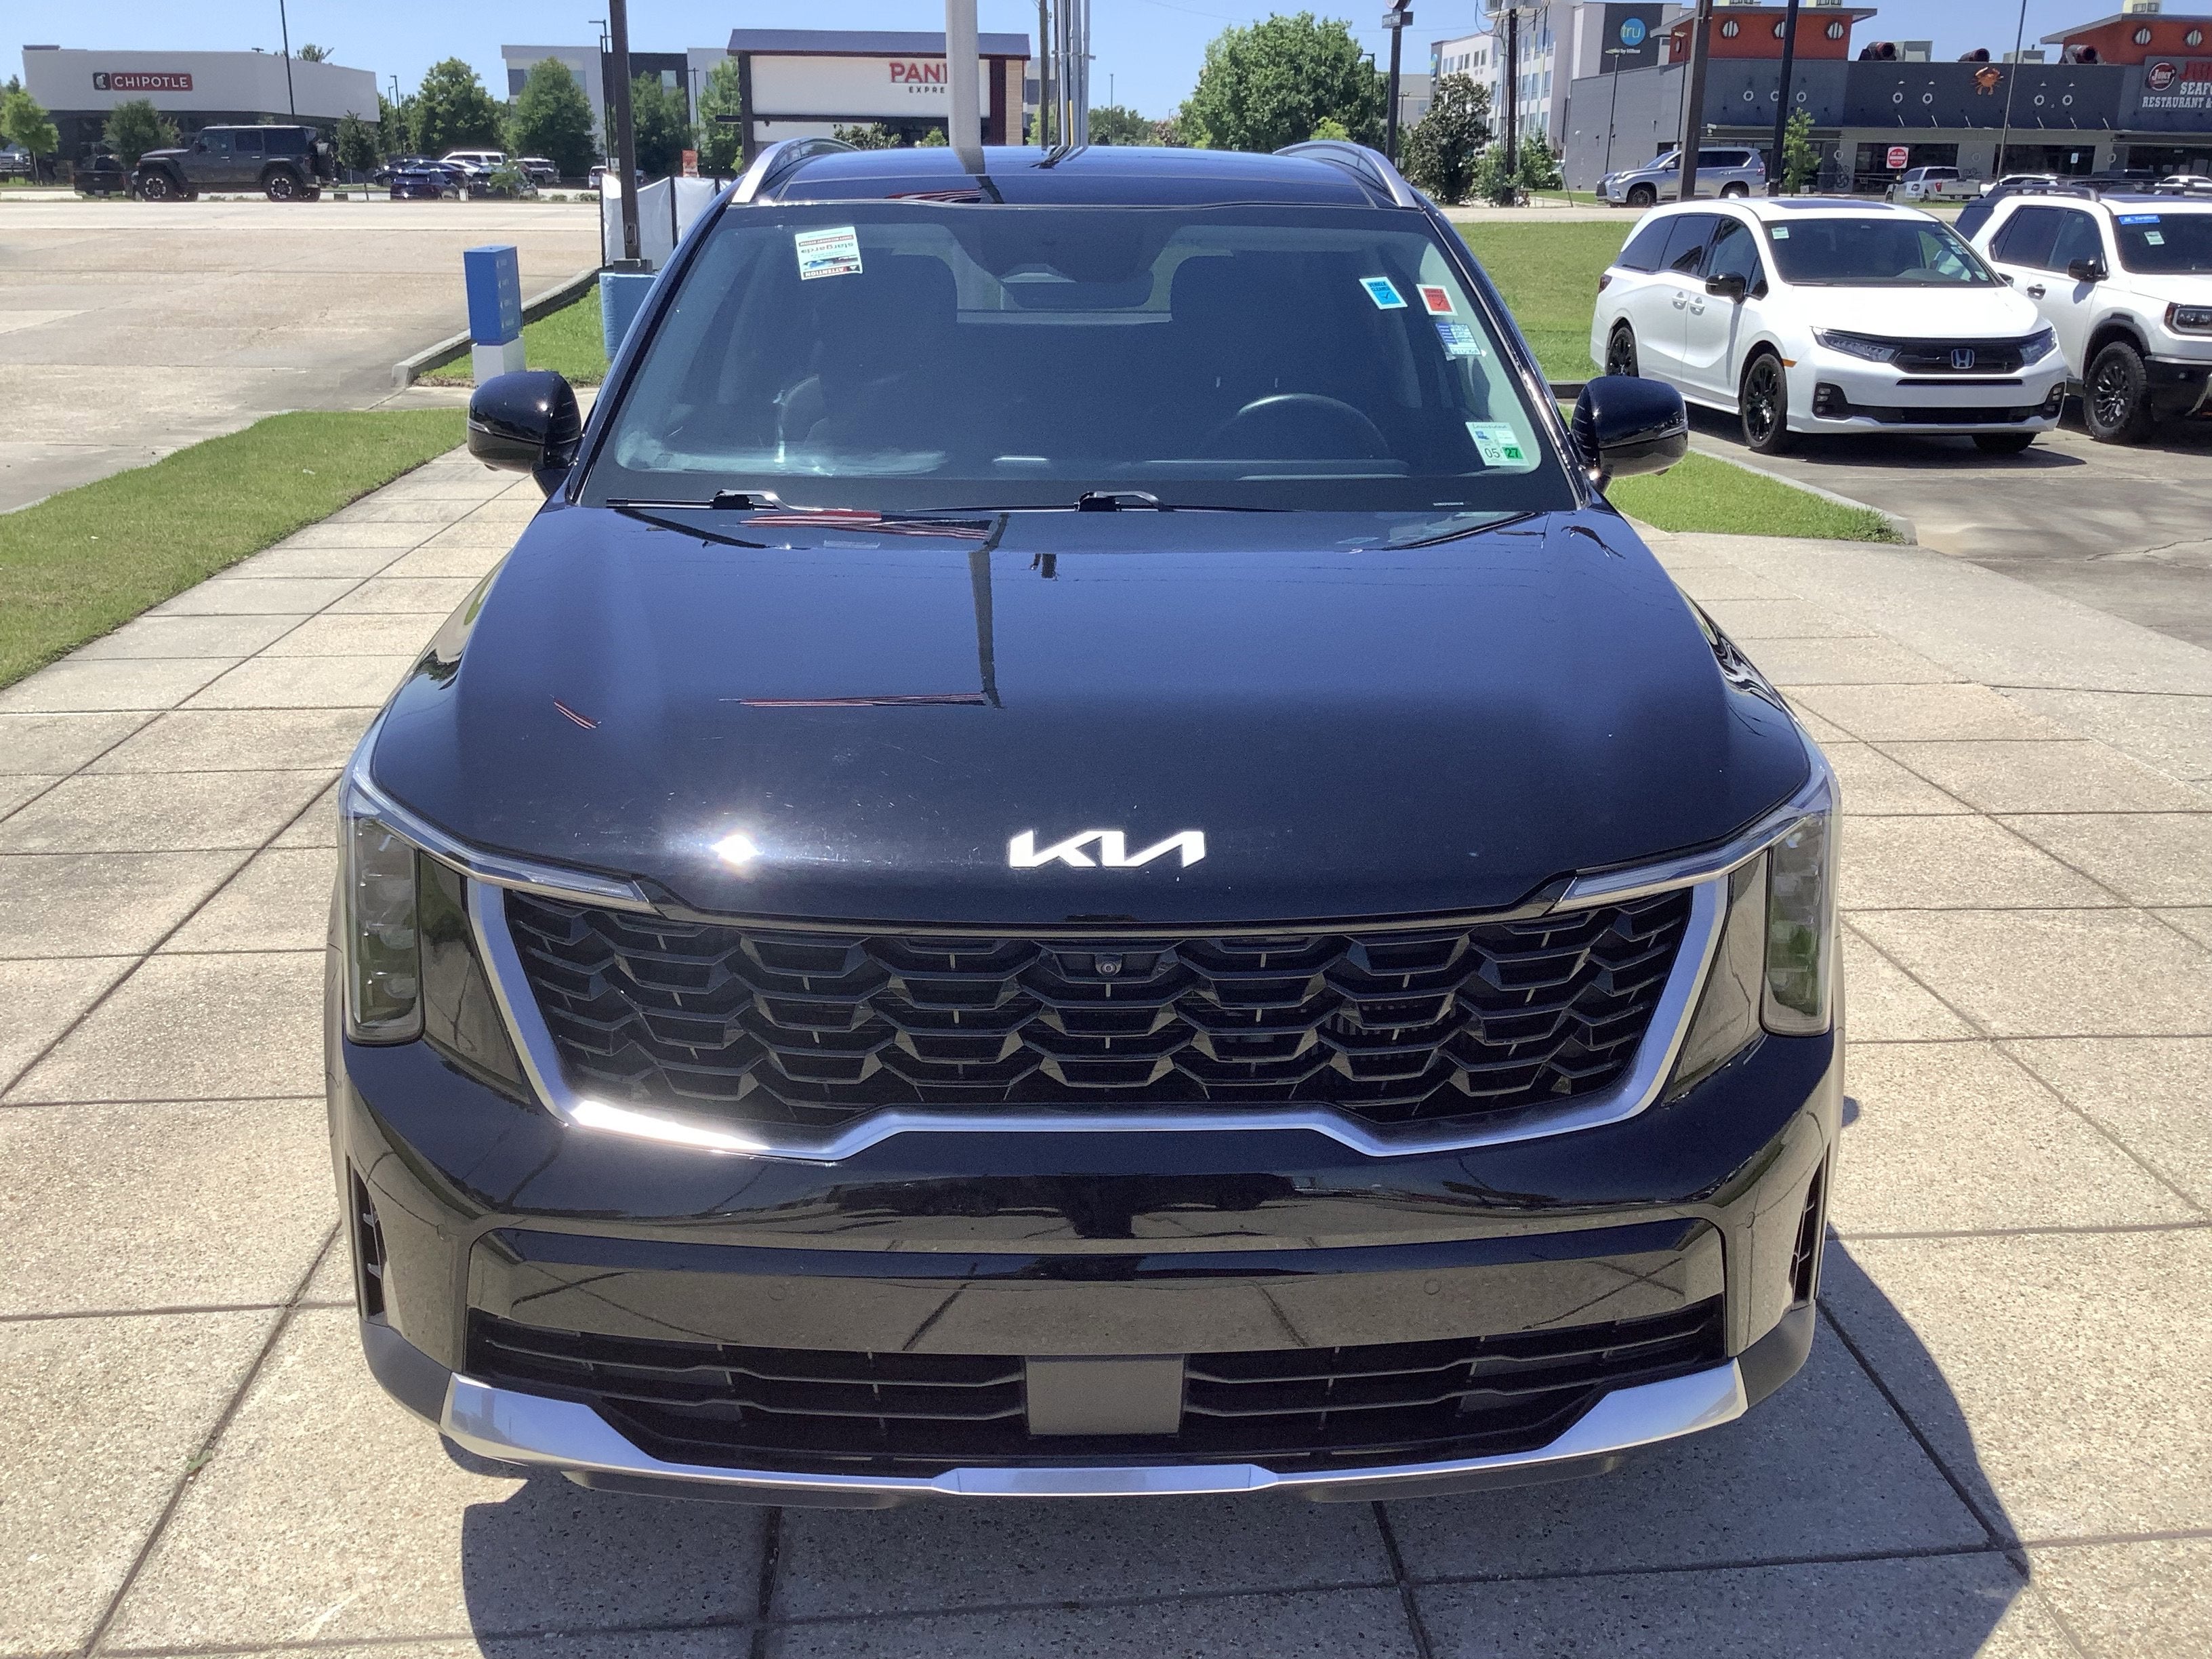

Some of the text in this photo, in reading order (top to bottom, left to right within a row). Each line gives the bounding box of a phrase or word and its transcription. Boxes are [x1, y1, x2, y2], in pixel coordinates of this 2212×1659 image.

[1622, 24, 1641, 39] tru
[114, 76, 188, 88] CHIPOTLE
[2179, 81, 2212, 96] SEAF
[2142, 96, 2204, 108] RESTAURANT
[805, 266, 844, 277] ATTENTION
[1484, 447, 1519, 458] 05 27
[1009, 830, 1206, 868] KIA
